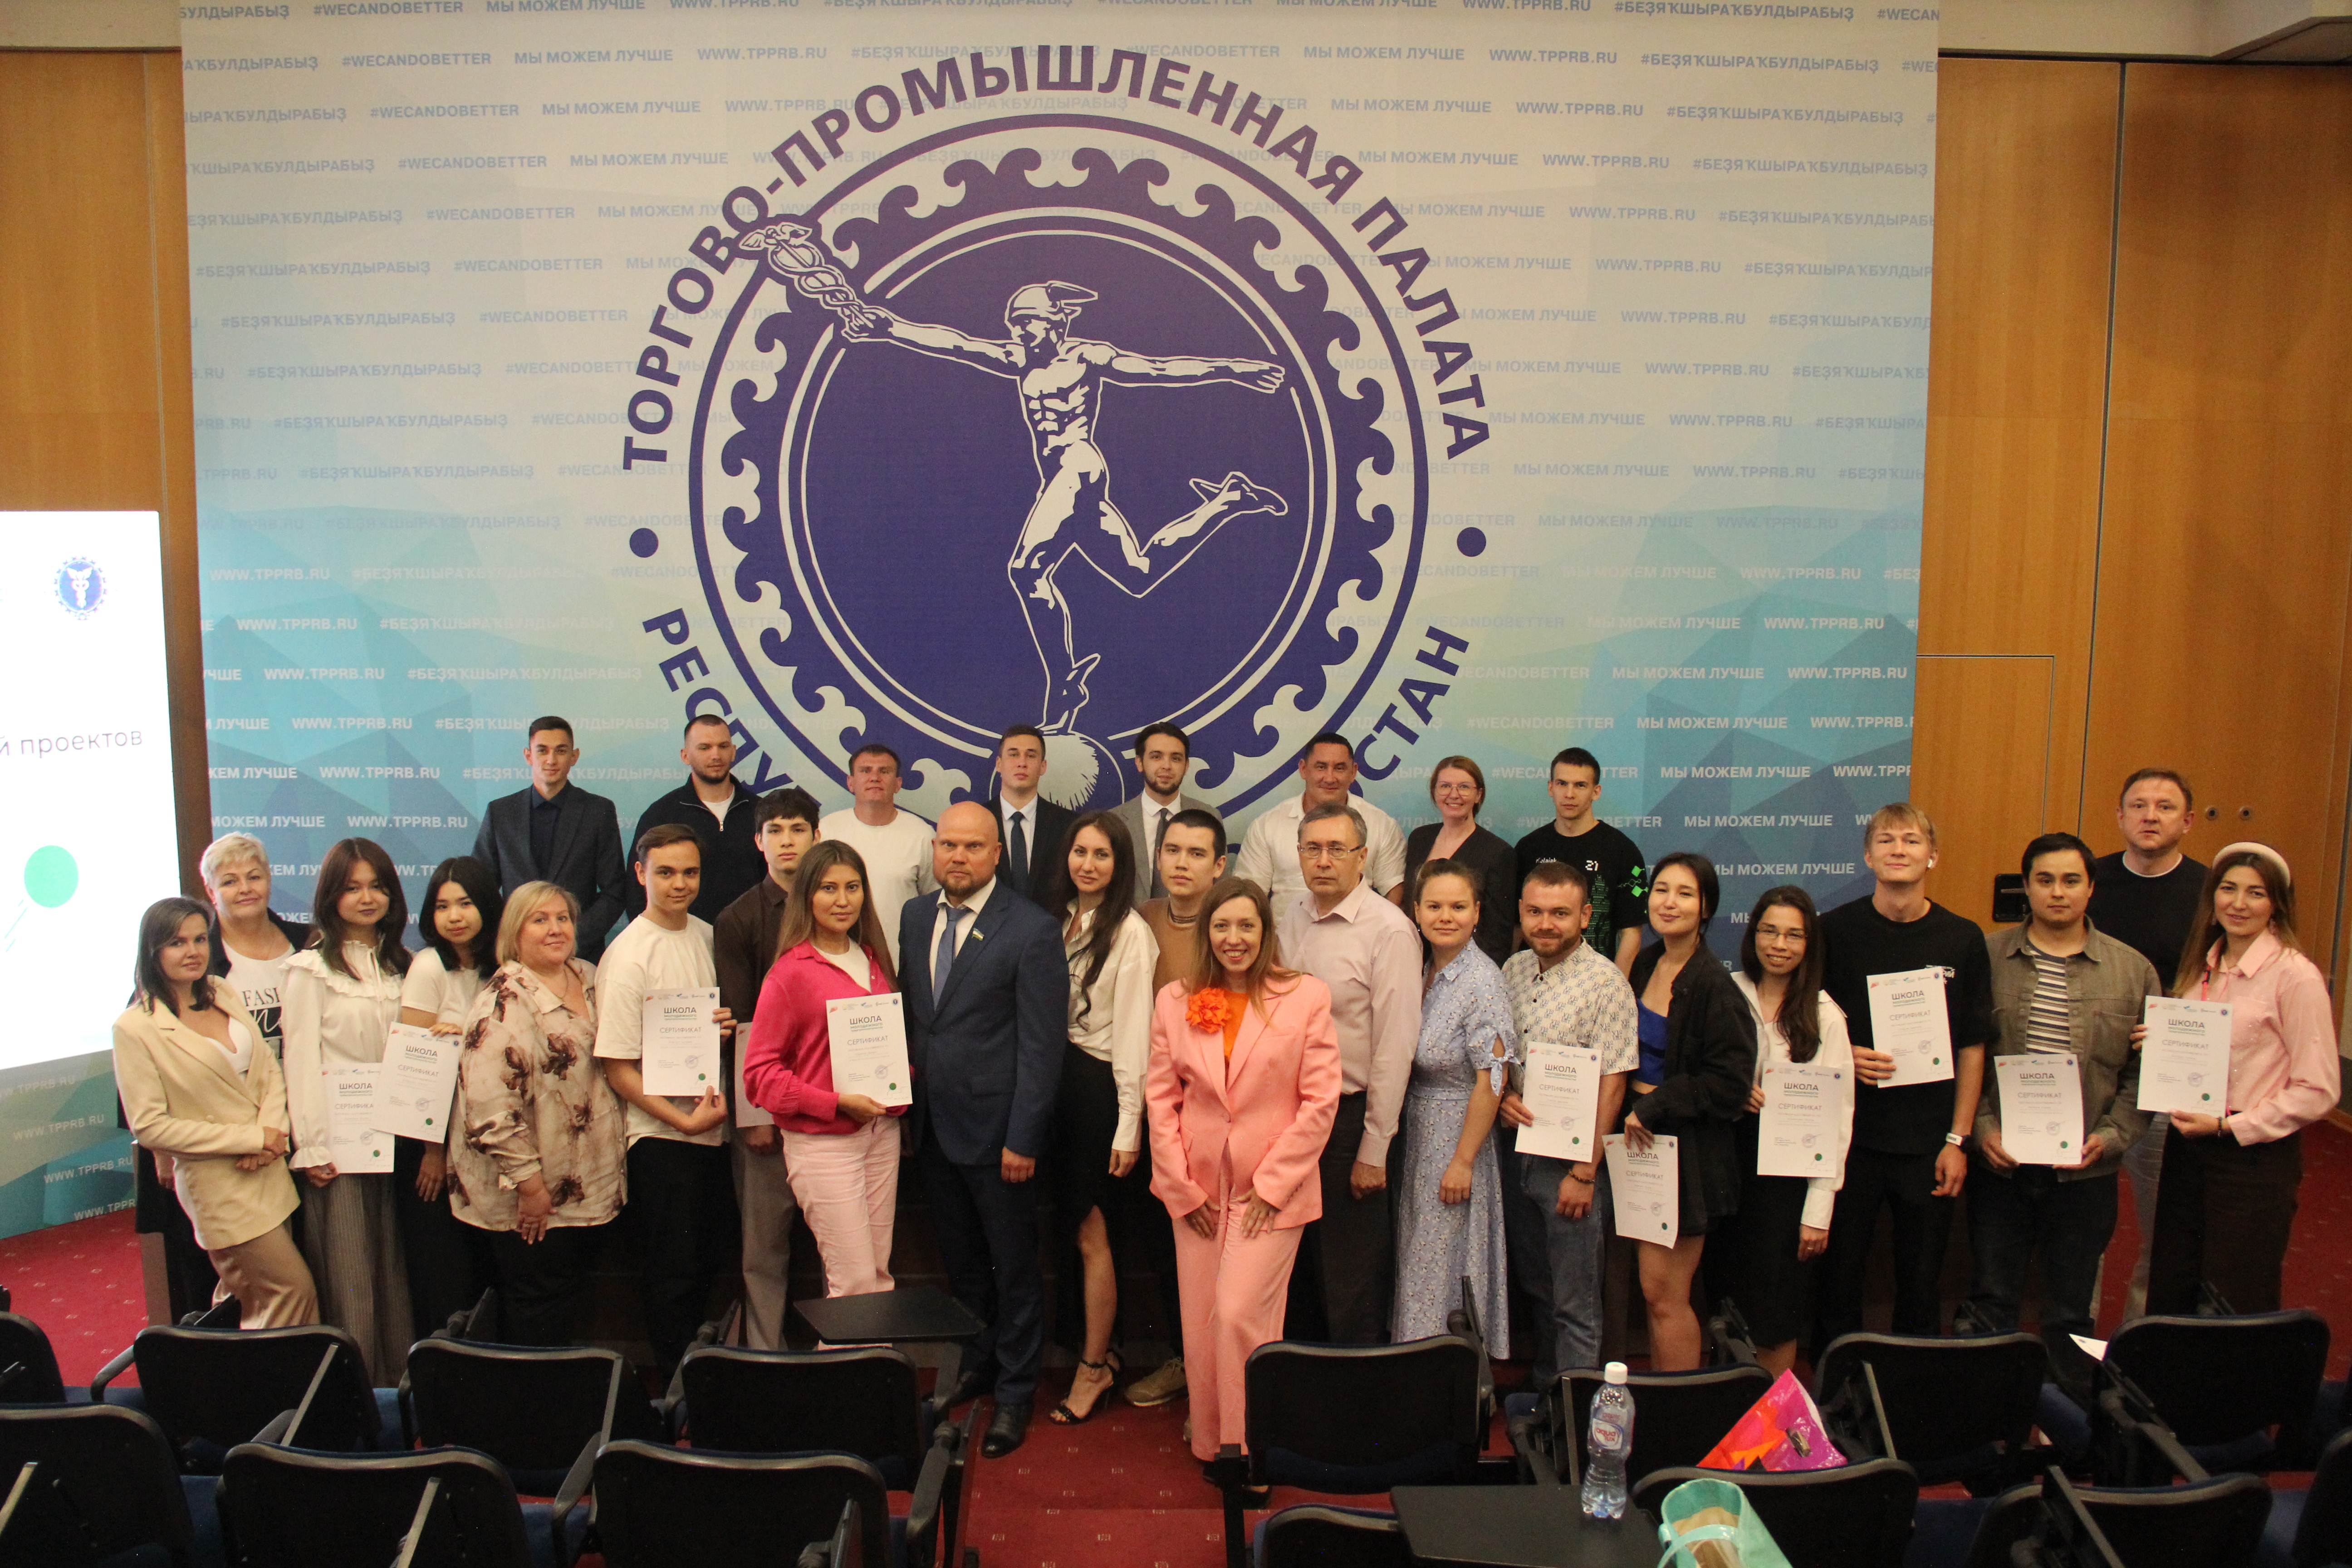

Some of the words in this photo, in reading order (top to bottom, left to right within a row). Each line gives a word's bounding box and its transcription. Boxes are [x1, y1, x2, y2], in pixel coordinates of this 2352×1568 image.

[314, 1, 463, 15] #WECANDOBETTER
[486, 1, 514, 12] МЫ
[519, 0, 583, 11] МОЖЕМ
[587, 0, 645, 10] ЛУЧШЕ
[514, 52, 542, 64] МЫ
[547, 51, 610, 63] МОЖЕМ
[615, 49, 673, 61] ЛУЧШЕ
[697, 47, 827, 60] WWW.TPPRB.RU
[1125, 45, 1280, 59] #WECANDOBETTER
[1304, 46, 1332, 58] МЫ
[1337, 47, 1401, 59] МОЖЕМ
[1406, 48, 1464, 60] ЛУЧШЕ
[1490, 49, 1617, 64] WWW.TPPRB.RU
[342, 53, 491, 67] #WECANDOBETTER
[371, 104, 519, 118] #WECANDOBETTER
[543, 103, 569, 115] МЫ
[574, 102, 638, 114] МОЖЕМ
[642, 101, 700, 113] ЛУЧШЕ
[1331, 99, 1359, 110] МЫ
[1364, 99, 1428, 111] МОЖЕМ
[1434, 100, 1491, 113] ЛУЧШЕ
[1516, 102, 1643, 116] WWW.TPPRB.RU
[398, 155, 547, 169] #WECANDOBETTER
[570, 155, 598, 166] МЫ
[602, 153, 666, 166] МОЖЕМ
[671, 152, 728, 165] ЛУЧШЕ
[1359, 151, 1386, 162] МЫ
[1391, 151, 1455, 163] МОЖЕМ
[1460, 153, 1518, 165] ЛУЧШЕ
[1543, 154, 1669, 168] WWW.TPPRB.RU
[426, 207, 574, 220] #WECANDOBETTER
[598, 206, 625, 217] МЫ
[630, 205, 694, 217] МОЖЕМ
[1418, 204, 1483, 216] МОЖЕМ
[1487, 205, 1545, 217] ЛУЧШЕ
[1569, 206, 1695, 221] WWW.TPPRB.RU
[454, 258, 602, 271] #WECANDOBETTER
[626, 257, 653, 269] МЫ
[1446, 256, 1509, 268] МОЖЕМ
[1514, 257, 1571, 270] ЛУЧШЕ
[1596, 259, 1721, 273] WWW.TPPRB.RU
[479, 309, 627, 323] #WECANDOBETTER
[1471, 309, 1535, 320] МОЖЕМ
[1539, 309, 1596, 321] ЛУЧШЕ
[1621, 311, 1745, 324] WWW.TPPRB.RU
[1352, 196, 1490, 460] ПАЛАТА
[1465, 360, 1492, 372] МЫ
[1496, 360, 1560, 372] МОЖЕМ
[1564, 361, 1621, 373] ЛУЧШЕ
[1645, 363, 1769, 376] WWW.TPPRB.RU
[1489, 412, 1516, 425] МЫ
[1521, 412, 1584, 424] МОЖЕМ
[1588, 413, 1645, 425] ЛУЧШЕ
[1669, 414, 1792, 427] WWW.TPPRB.RU
[1514, 464, 1541, 475] МЫ
[1545, 464, 1608, 475] МОЖЕМ
[1613, 465, 1669, 476] ЛУЧШЕ
[1693, 465, 1815, 478] WWW.TPPRB.RU
[210, 568, 330, 580] WWW.TPPRB.RU
[1594, 566, 1657, 578] МОЖЕМ
[1661, 566, 1716, 579] ЛУЧШЕ
[1741, 567, 1862, 580] WWW.TPPRB.RU
[236, 618, 358, 630] WWW.TPPRB.RU
[1619, 617, 1681, 629] МОЖЕМ
[1686, 617, 1741, 629] ЛУЧШЕ
[1764, 617, 1884, 629] WWW.TPPRB.RU
[263, 668, 385, 680] WWW.TPPRB.RU
[1613, 667, 1640, 678] МЫ
[1644, 667, 1706, 679] МОЖЕМ
[1709, 667, 1764, 679] ЛУЧШЕ
[1788, 667, 1907, 678] WWW.TPPRB.RU
[215, 718, 270, 730] ЛУЧШЕ
[291, 717, 412, 729] WWW.TPPRB.RU
[1467, 716, 1615, 730] #WECANDOBETTER
[1637, 717, 1664, 728] МЫ
[1667, 717, 1729, 729] МОЖЕМ
[1733, 717, 1788, 728] ЛУЧШЕ
[21, 731, 142, 759] проектов
[243, 767, 297, 779] ЛУЧШЕ
[319, 767, 440, 779] WWW.TPPRB.RU
[1661, 767, 1688, 778] МЫ
[1692, 767, 1752, 778] МОЖЕМ
[1756, 766, 1811, 778] ЛУЧШЕ
[270, 816, 325, 828] ЛУЧШЕ
[347, 816, 467, 828] WWW.TPPRB.RU
[1685, 816, 1710, 827] МЫ
[1715, 815, 1775, 827] МОЖЕМ
[1779, 815, 1833, 826] ЛУЧШЕ
[1738, 864, 1798, 875] МОЖЕМ
[1801, 863, 1855, 874] ЛУЧШЕ
[1891, 990, 1924, 1000] ШКОЛА
[850, 1015, 882, 1025] ШКОЛА
[1890, 1010, 1931, 1020] СЕРТИФИКАТ
[2169, 1019, 2205, 1029] ШКОЛА
[848, 1035, 888, 1045] СЕРТИФИКАТ
[2162, 1040, 2209, 1049] СЕРТИФИКАТ
[406, 1045, 437, 1057] ШКОЛА
[398, 1065, 439, 1077] СЕРТИФИКАТ
[1545, 1064, 1577, 1073] ШКОЛА
[1539, 1084, 1579, 1094] СЕРТИФИКАТ
[1784, 1083, 1818, 1091] ШКОЛА
[44, 1156, 133, 1184] WWW.TPPRB.RU
[1626, 1171, 1663, 1180] СЕРТИФИКАТ
